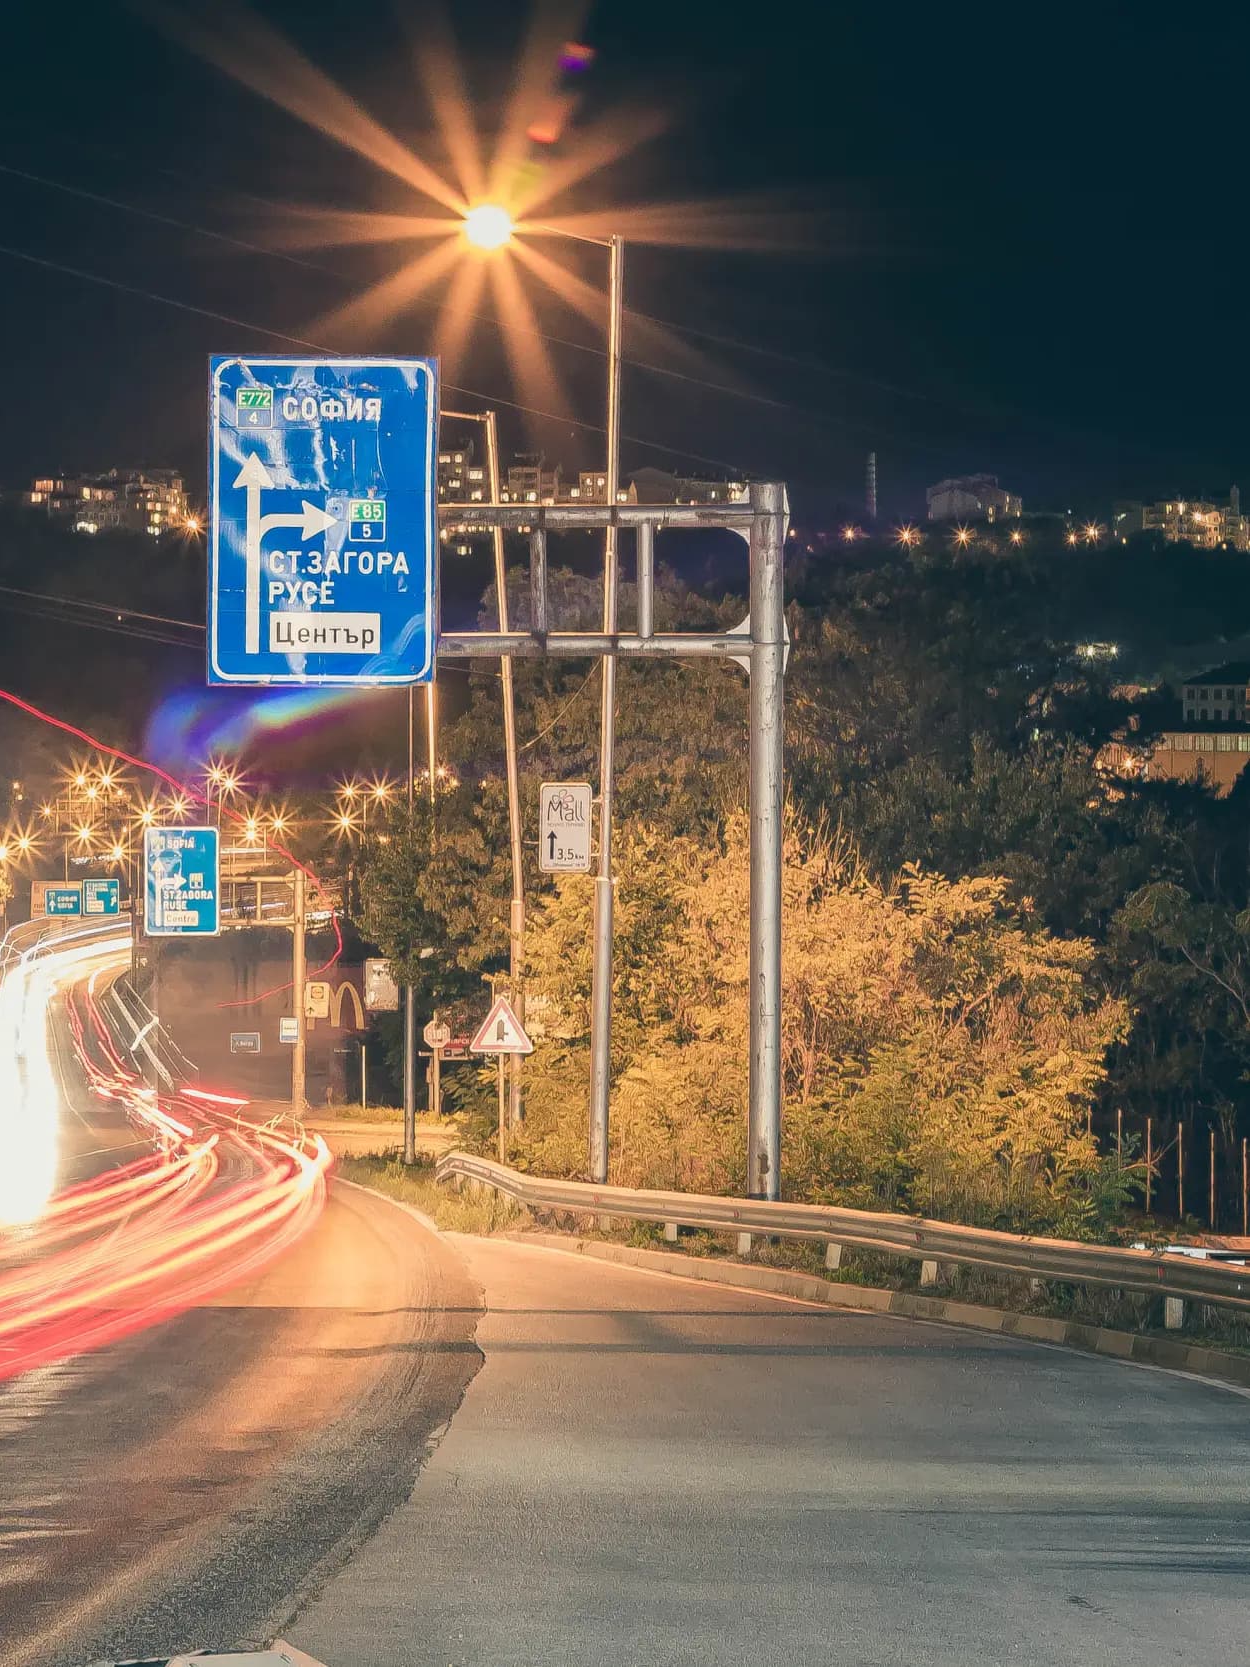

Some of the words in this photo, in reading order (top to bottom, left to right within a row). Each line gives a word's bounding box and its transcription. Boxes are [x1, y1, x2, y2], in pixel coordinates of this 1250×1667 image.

[239, 390, 270, 406] E772
[283, 397, 381, 420] СОФИЯ
[249, 411, 258, 424] 4
[362, 523, 371, 538] 5
[269, 550, 410, 575] СТ.ЗАГОРА
[268, 581, 335, 605] РУСЕ
[275, 621, 375, 649] Център
[547, 800, 586, 821] Mall
[167, 837, 195, 849] SOFIA
